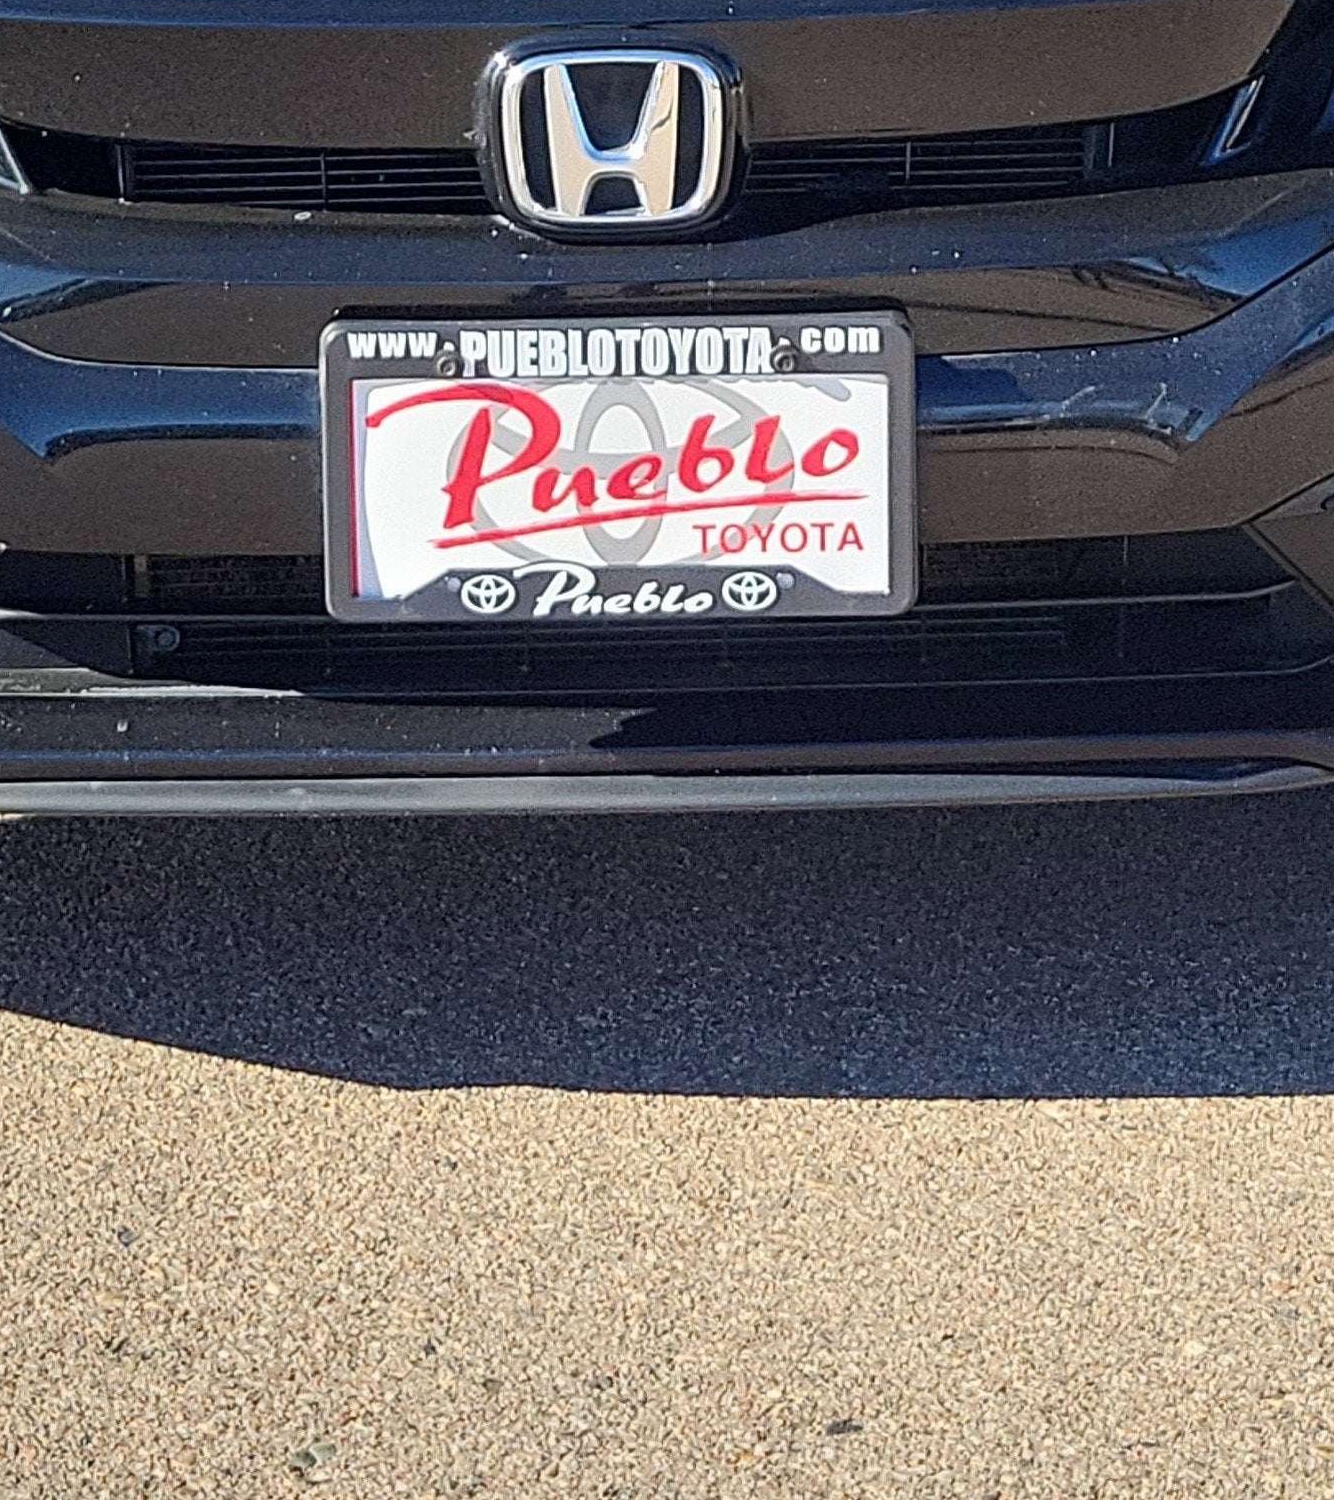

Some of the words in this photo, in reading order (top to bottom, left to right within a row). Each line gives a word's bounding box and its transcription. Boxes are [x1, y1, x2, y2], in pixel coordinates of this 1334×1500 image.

[365, 383, 861, 528] Pueblo
[691, 521, 864, 554] TOYOTA
[513, 561, 716, 618] Pueblo
